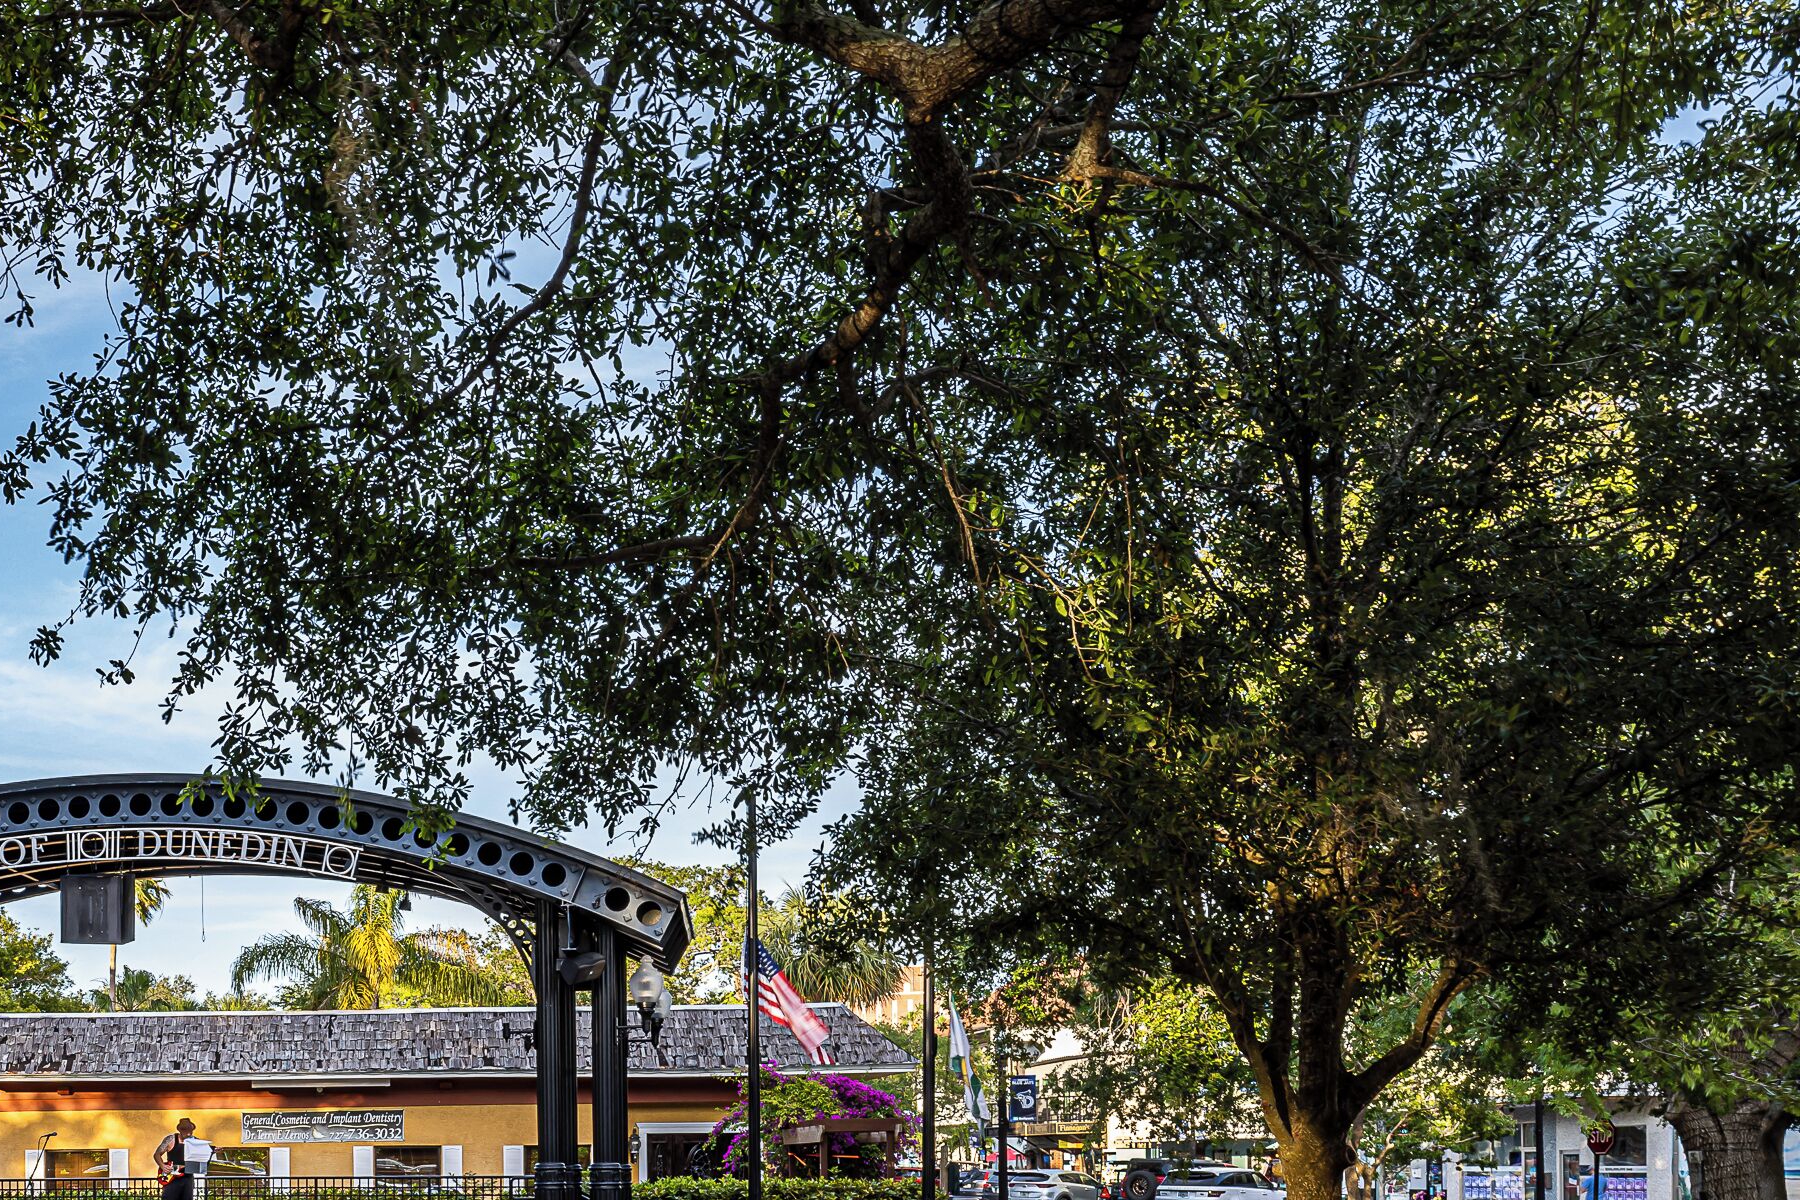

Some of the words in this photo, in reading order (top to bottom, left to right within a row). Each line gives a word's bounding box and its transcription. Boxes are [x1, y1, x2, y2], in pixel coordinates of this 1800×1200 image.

[136, 829, 309, 868] DUNEDIN
[275, 1113, 311, 1127] Cosmetic
[311, 1112, 329, 1124] and
[328, 1111, 362, 1126] Implant
[363, 1112, 403, 1127] Dentistry
[245, 1129, 256, 1140] Dr.
[257, 1129, 276, 1141] Terry
[284, 1130, 310, 1140] Zervos
[329, 1127, 402, 1140] 727-736-3032
[1590, 1130, 1612, 1143] STOP
